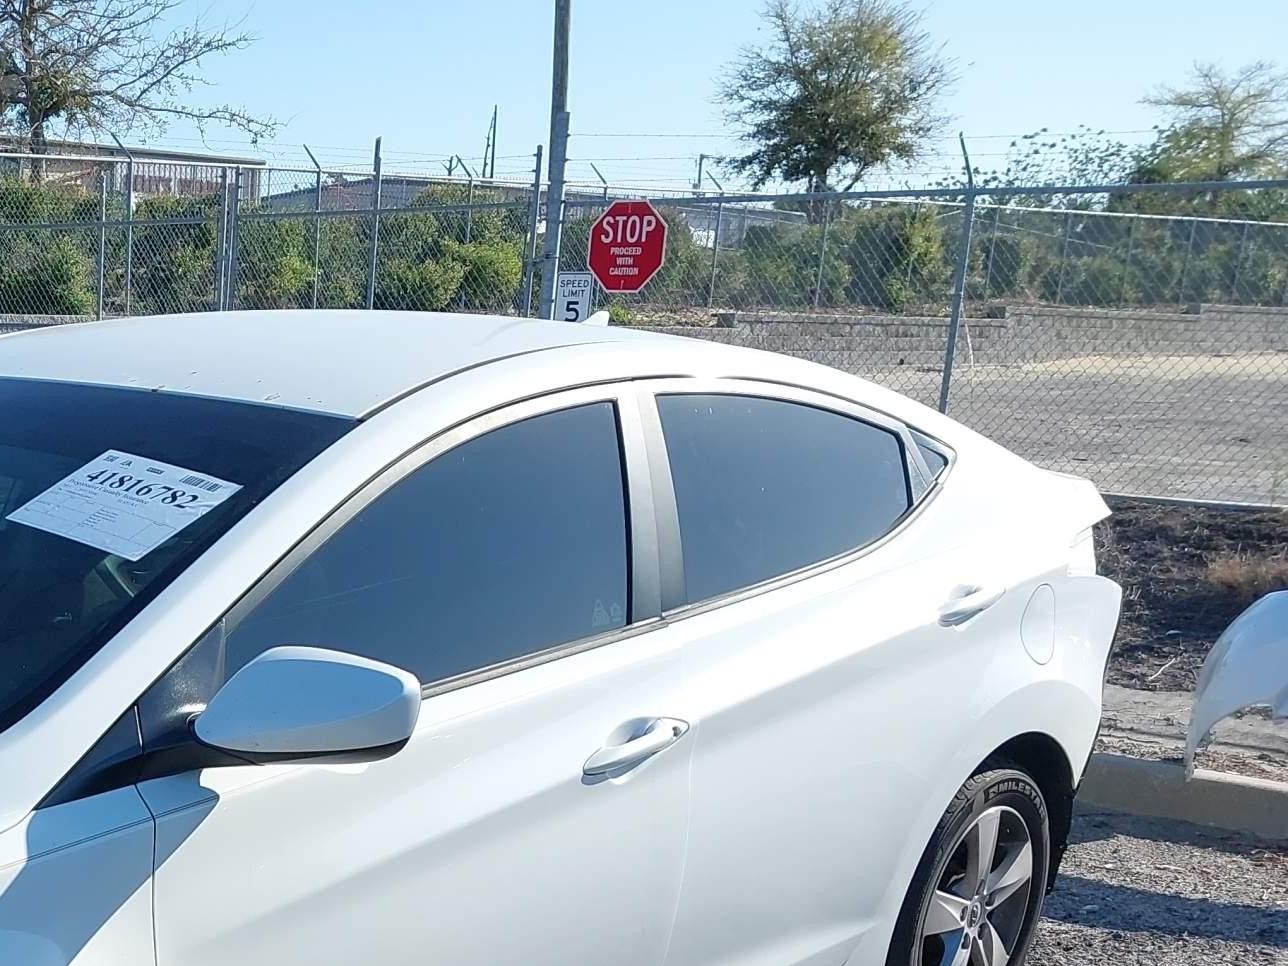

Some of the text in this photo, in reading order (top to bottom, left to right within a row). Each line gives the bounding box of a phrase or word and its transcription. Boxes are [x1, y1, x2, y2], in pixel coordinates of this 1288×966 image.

[601, 215, 656, 243] STOP
[610, 247, 642, 255] PROCEED
[616, 257, 633, 265] WITH
[609, 267, 639, 275] CAUTION
[560, 280, 589, 288] SPEED
[563, 289, 585, 298] LIMIT
[565, 301, 579, 322] 5
[85, 469, 199, 509] 41816782
[999, 781, 1046, 819] MILESTAR
